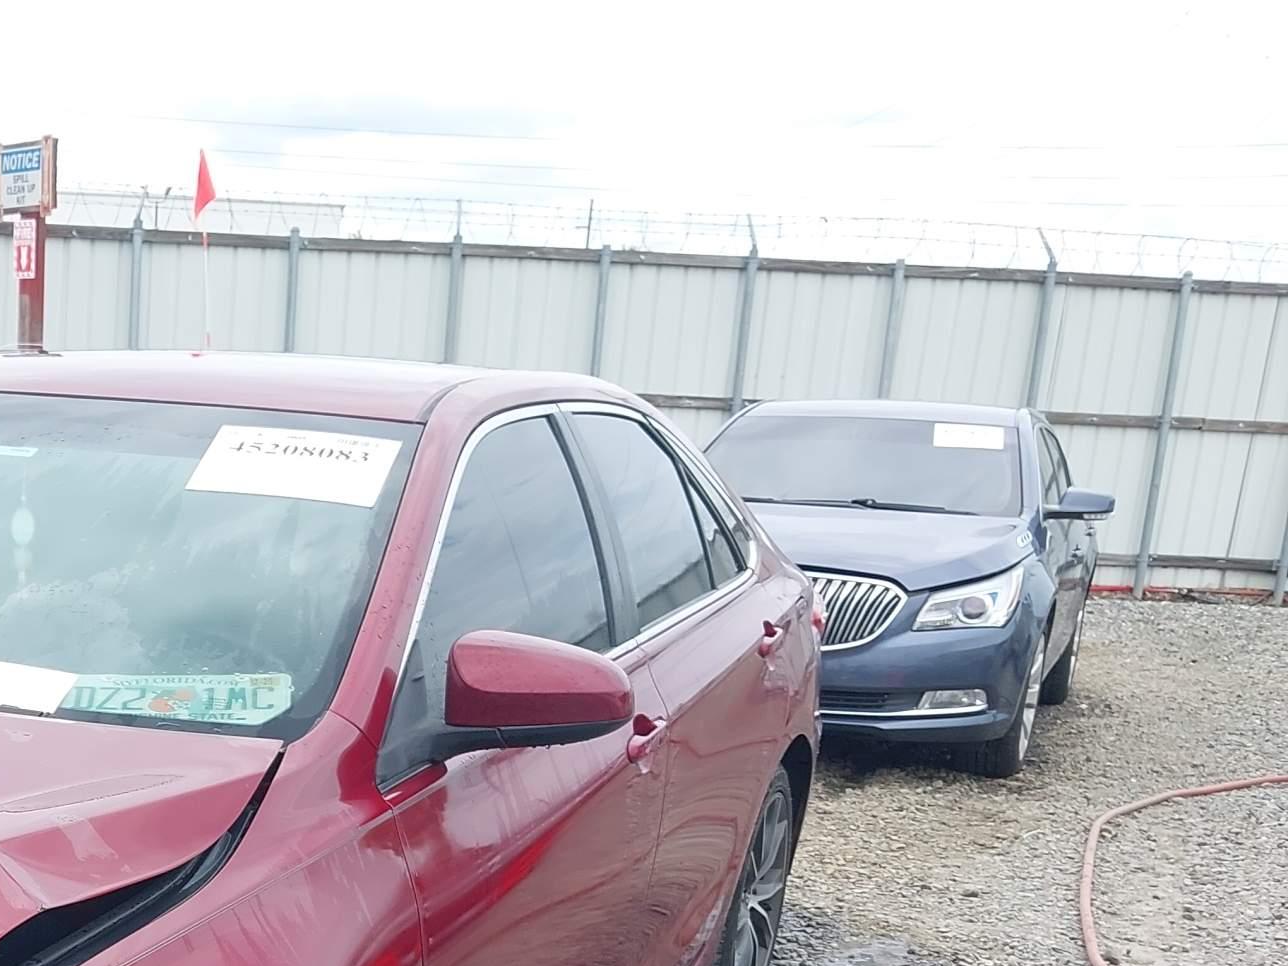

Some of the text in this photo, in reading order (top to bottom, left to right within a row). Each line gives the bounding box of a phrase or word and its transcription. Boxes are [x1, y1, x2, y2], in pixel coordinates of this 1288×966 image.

[3, 151, 39, 171] NOTICE
[13, 174, 29, 184] SPILL
[6, 183, 36, 195] CLEAN UP
[229, 441, 369, 463] 45208083
